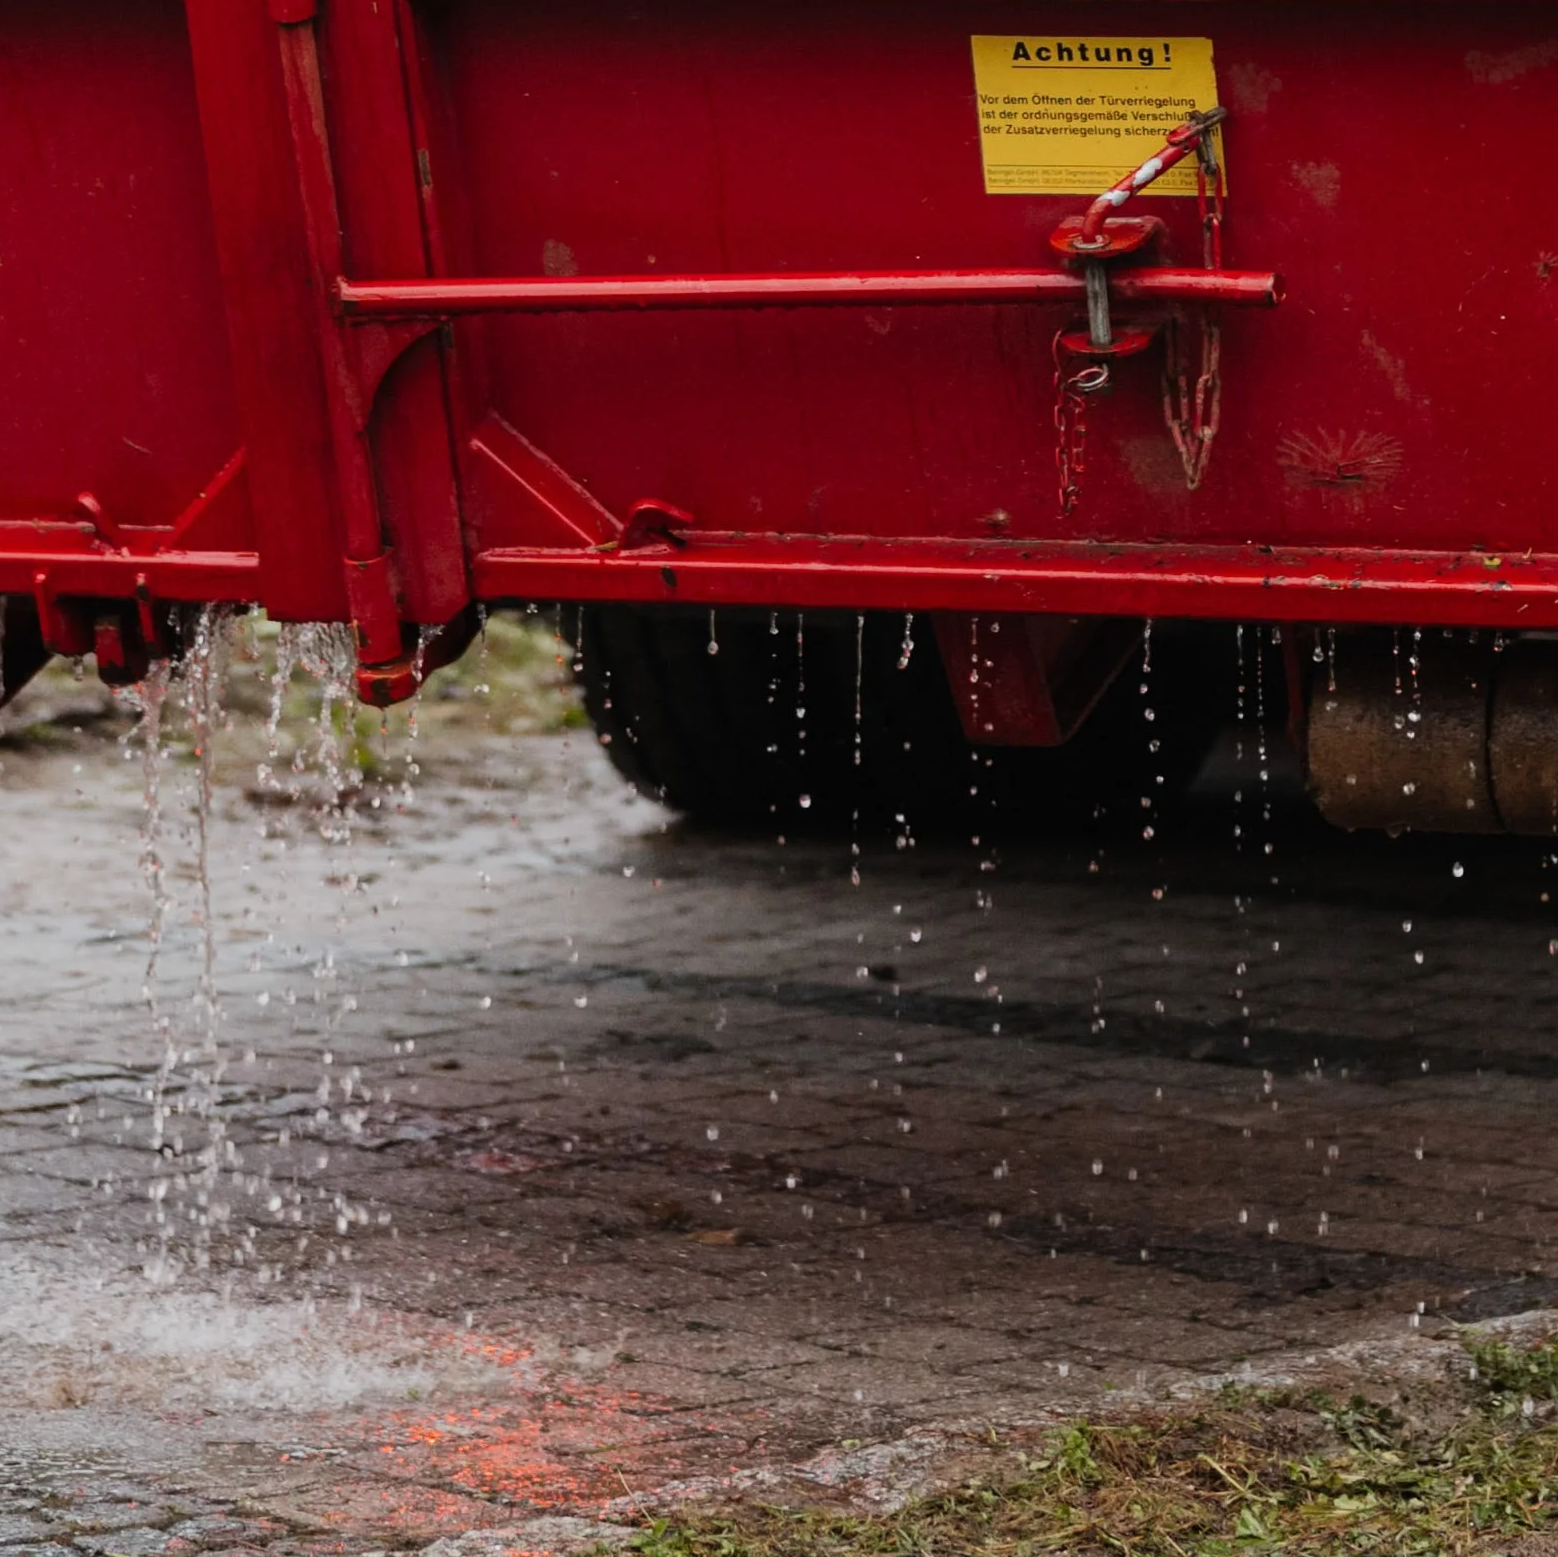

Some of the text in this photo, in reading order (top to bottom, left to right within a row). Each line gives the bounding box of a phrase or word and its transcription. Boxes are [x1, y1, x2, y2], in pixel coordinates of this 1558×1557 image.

[980, 92, 1196, 109] Vor dem Öffnen der Türverriegelung
[982, 109, 996, 119] ist
[999, 109, 1018, 120] der
[983, 124, 1002, 134] der
[1005, 124, 1122, 138] Zusatzverriegelung
